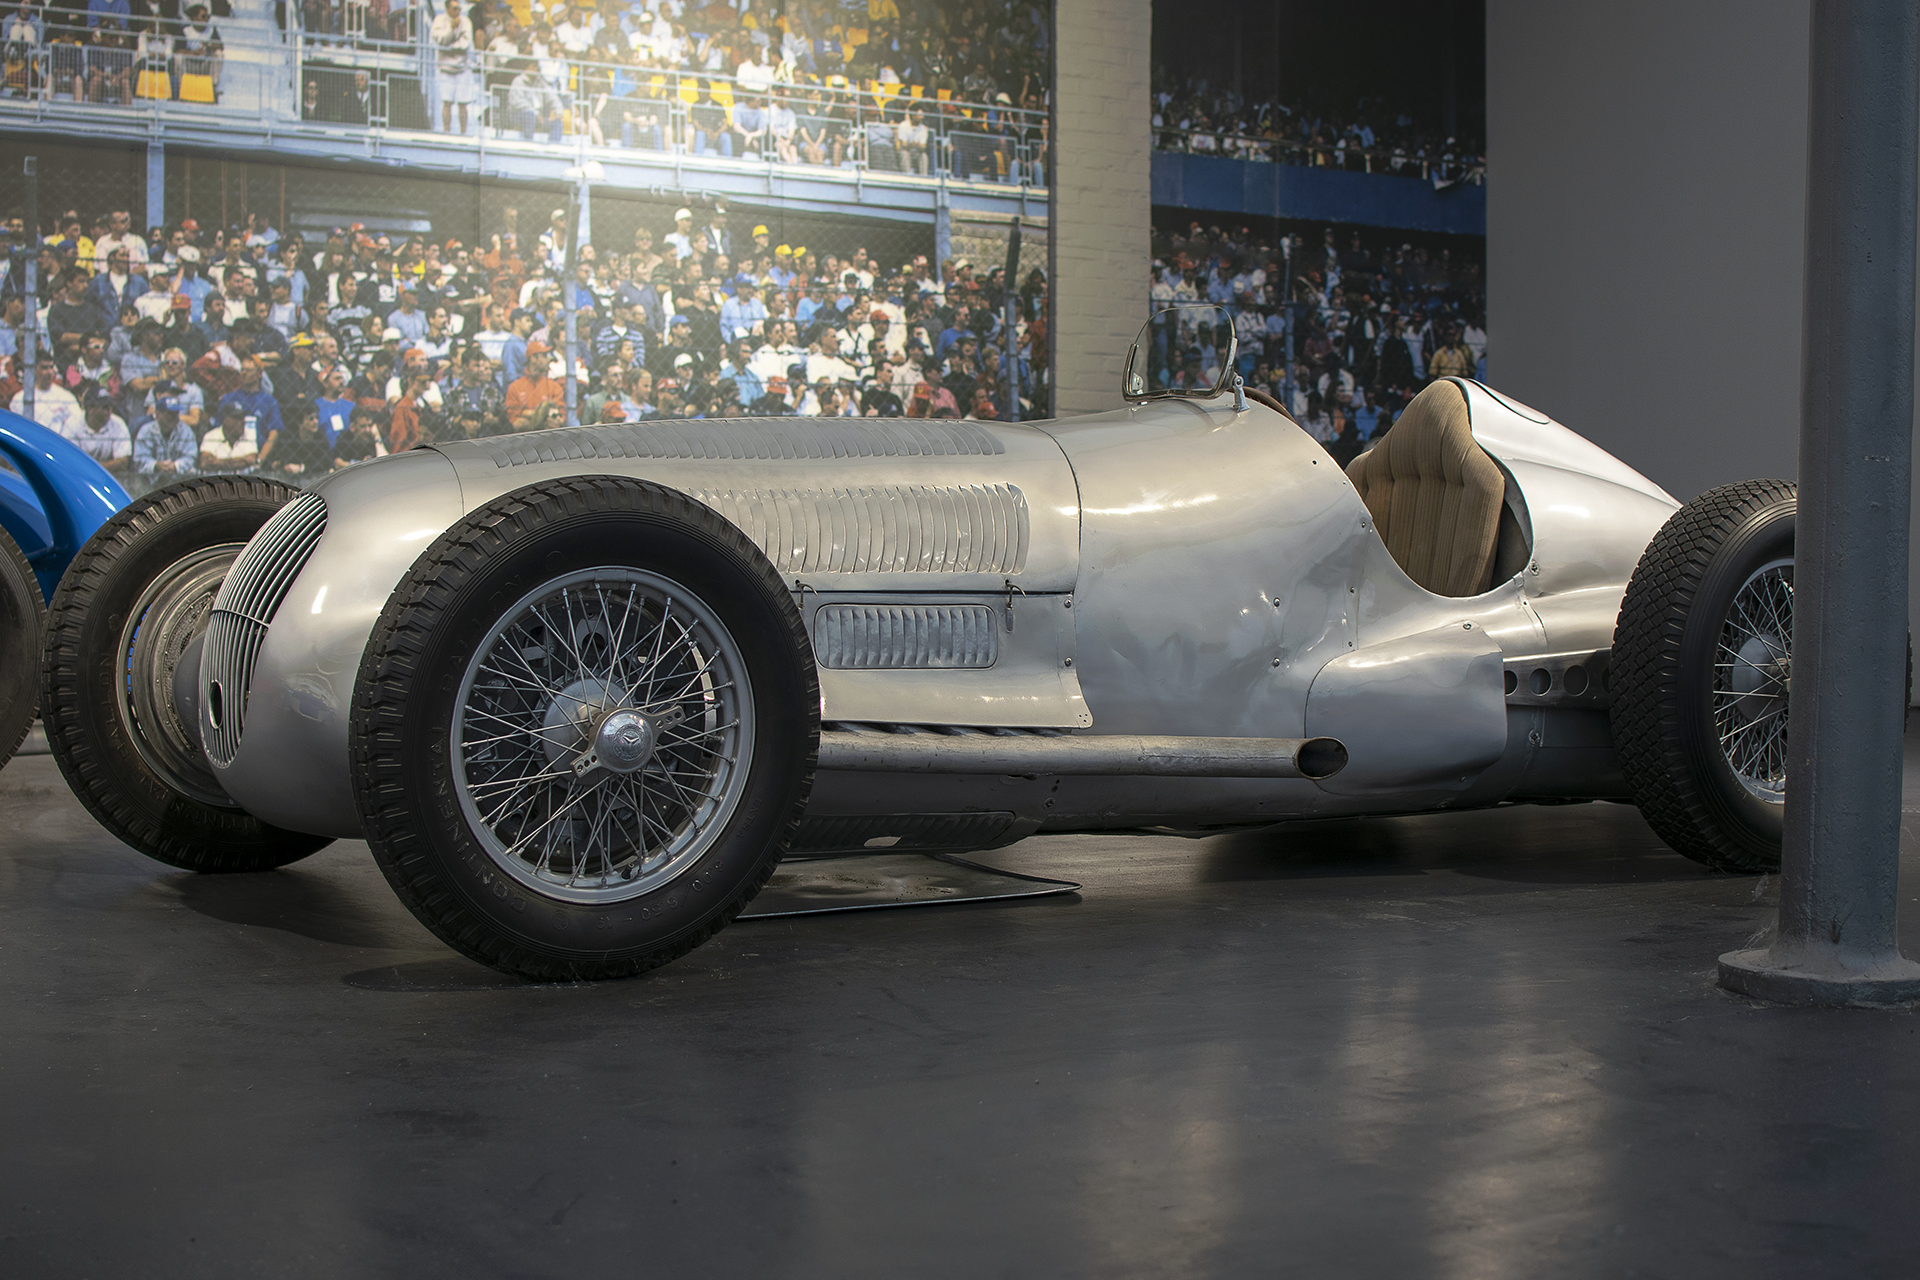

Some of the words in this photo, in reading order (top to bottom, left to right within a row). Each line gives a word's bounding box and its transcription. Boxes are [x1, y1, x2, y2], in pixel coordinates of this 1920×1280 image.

[98, 652, 132, 762] BALLON
[428, 716, 528, 914] CONTINENTAL
[736, 797, 763, 839] EXTRA
[595, 916, 614, 930] 19
